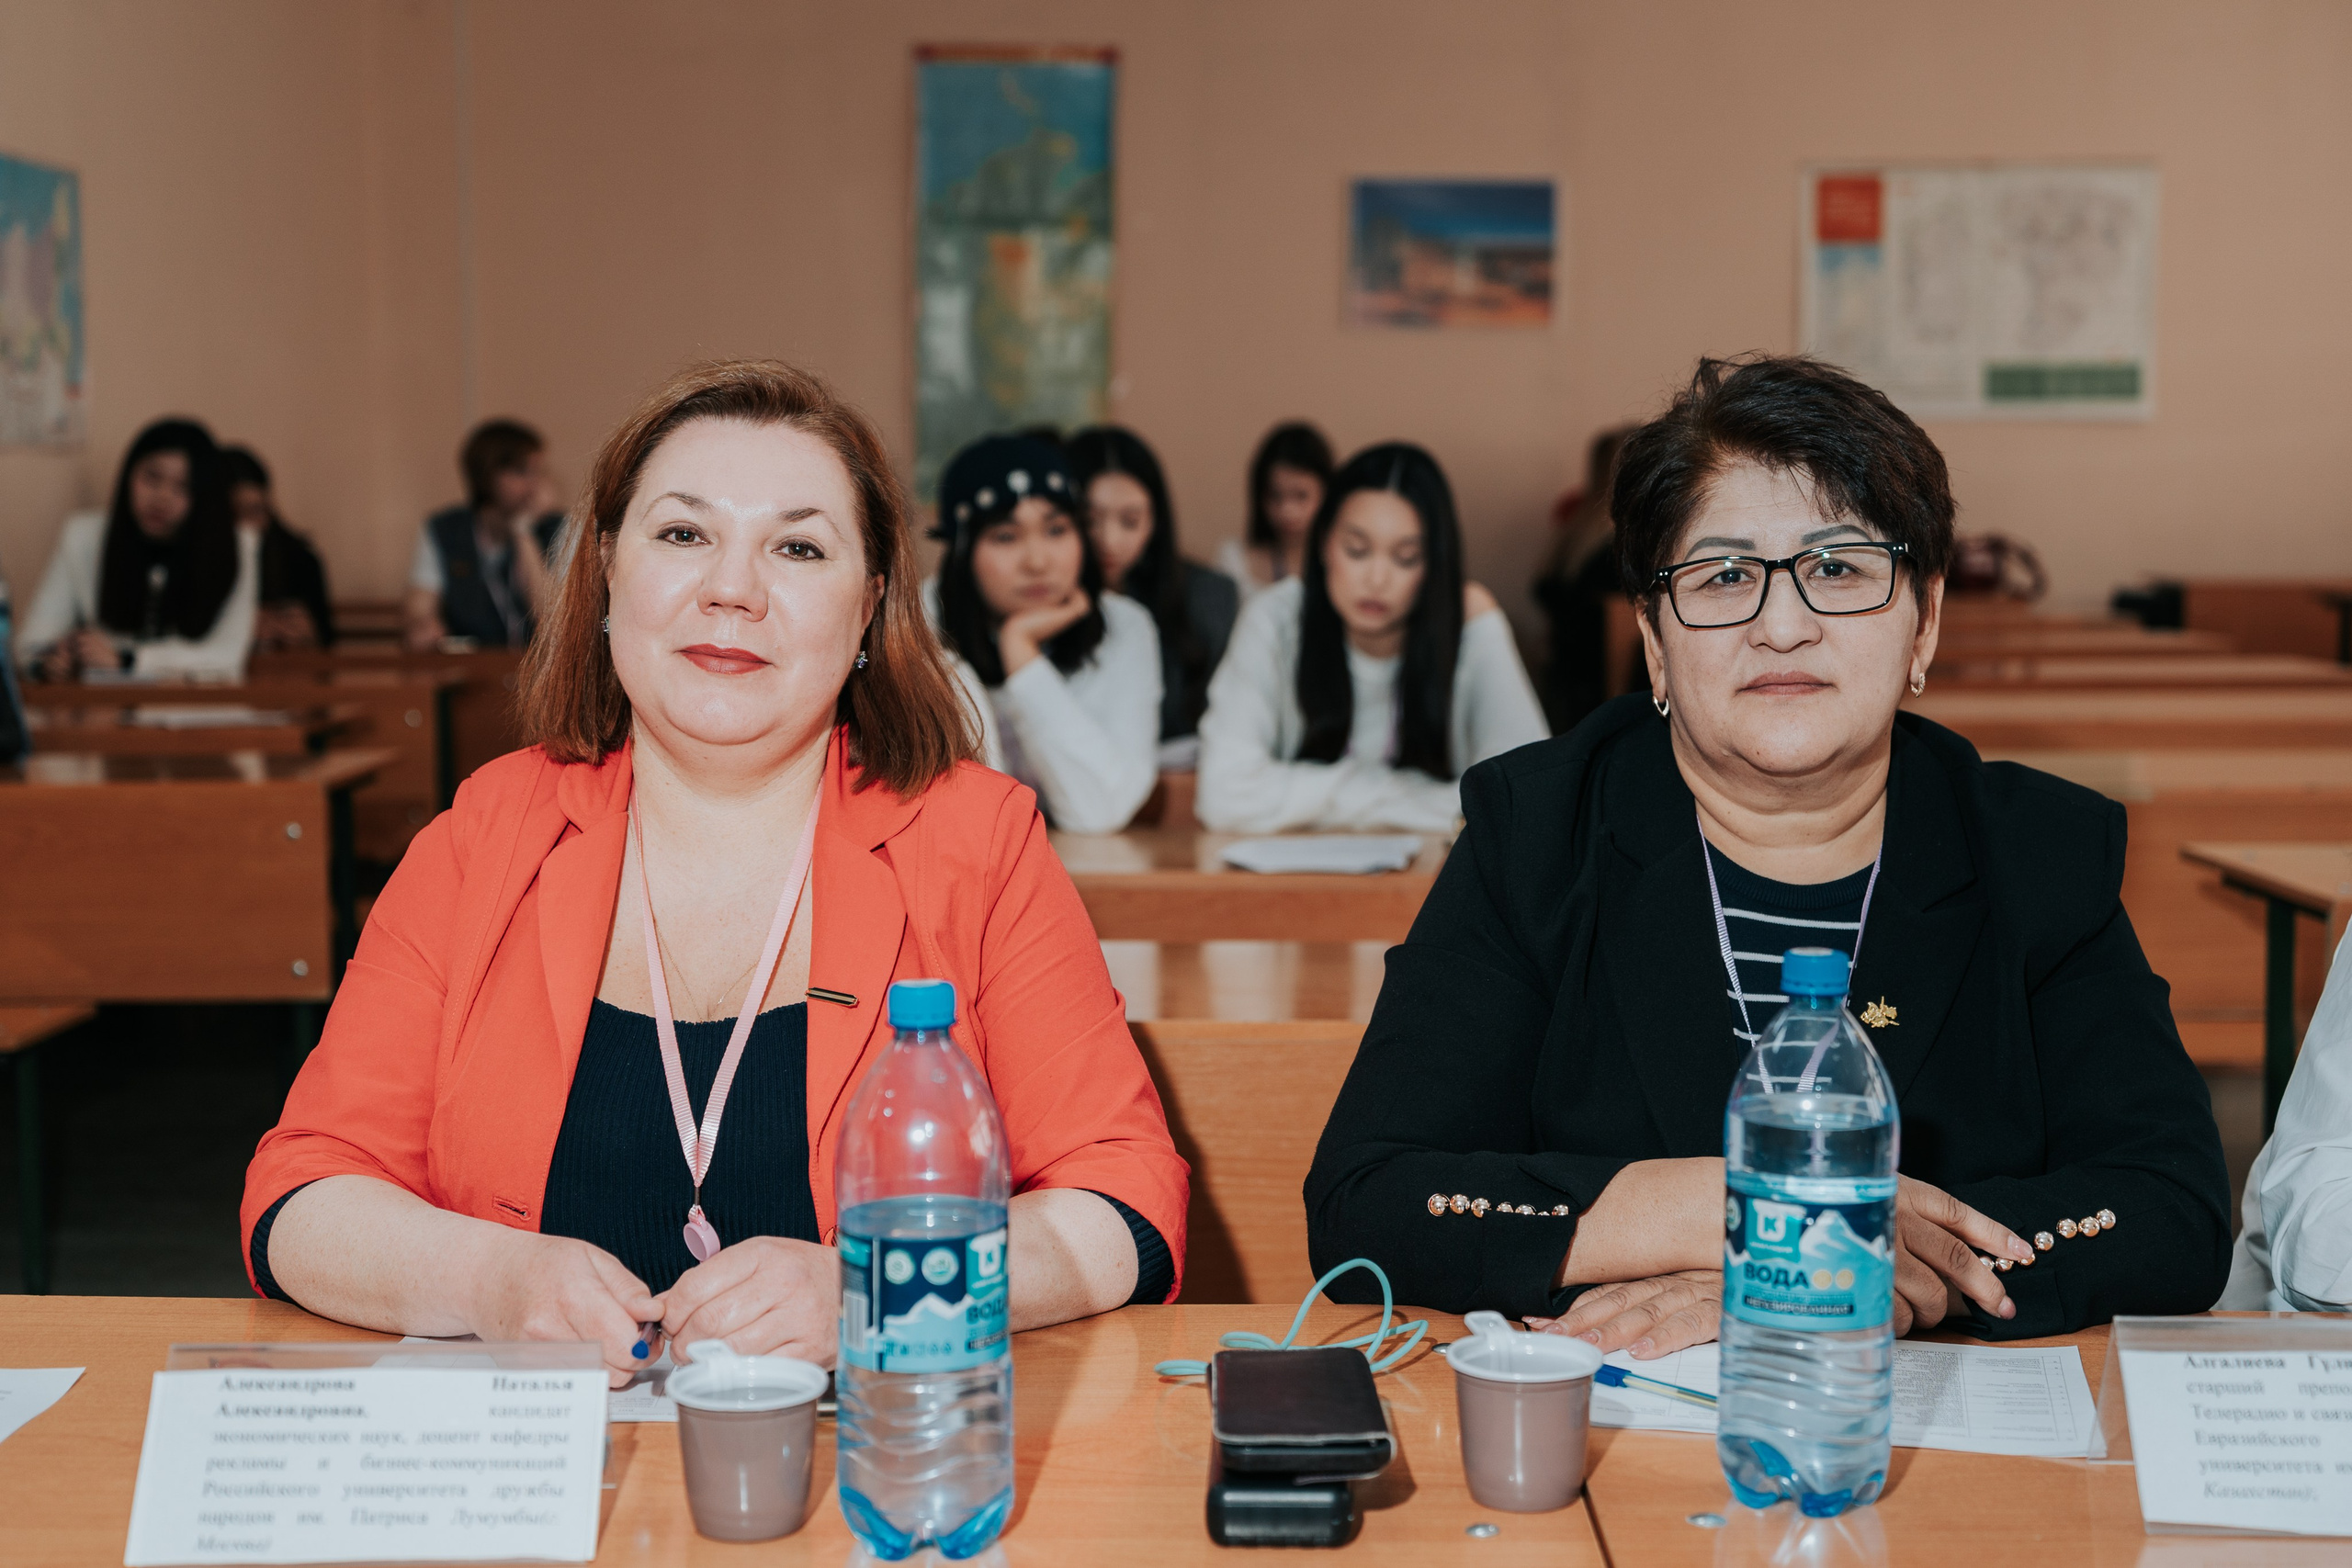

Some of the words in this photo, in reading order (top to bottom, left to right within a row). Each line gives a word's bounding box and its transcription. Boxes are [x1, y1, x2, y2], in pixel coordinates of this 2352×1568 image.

[1743, 1261, 1810, 1291] ВОДА
[2184, 1355, 2287, 1370] Алгалиева
[492, 1376, 574, 1392] Наталья
[2186, 1379, 2266, 1398] старший
[2189, 1403, 2289, 1424] Телерадио
[2194, 1428, 2322, 1450] Евразийского
